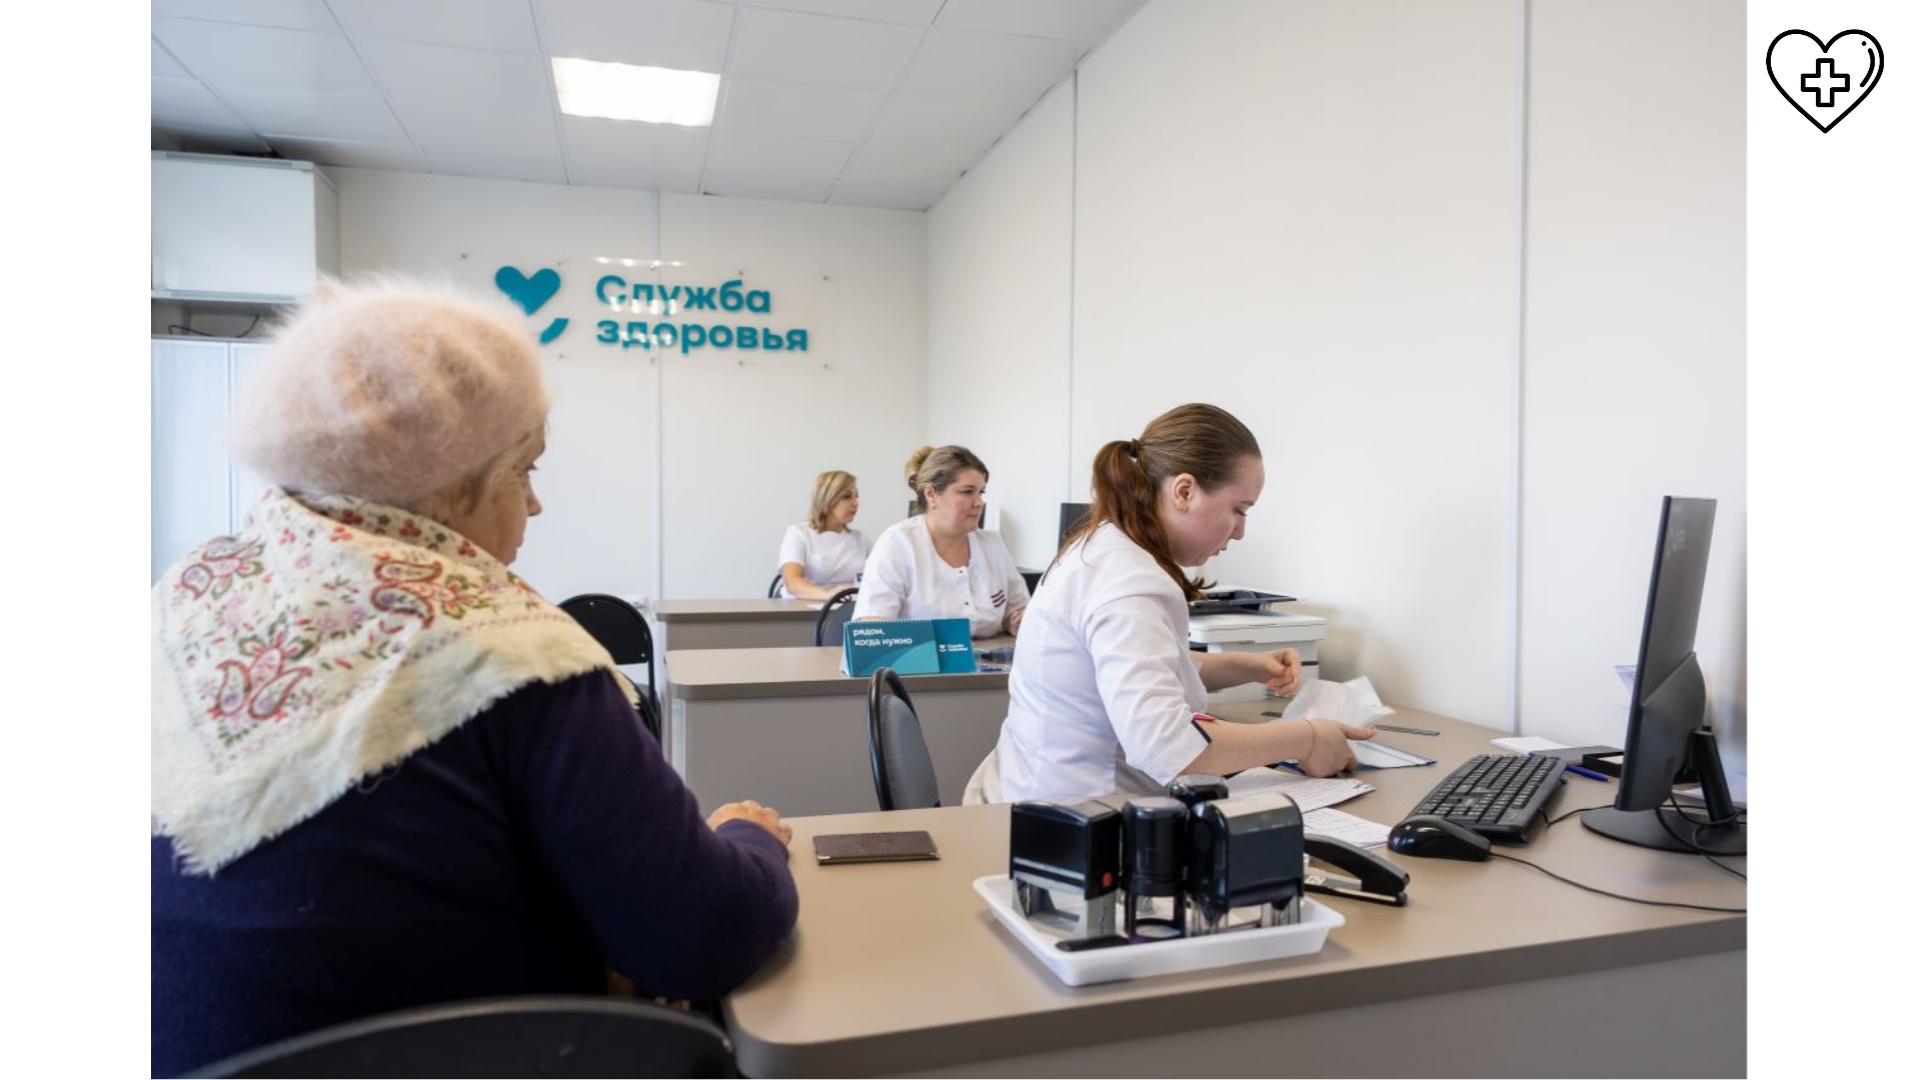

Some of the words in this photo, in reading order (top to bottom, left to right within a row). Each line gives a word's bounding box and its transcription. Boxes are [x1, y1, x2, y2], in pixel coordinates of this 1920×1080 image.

[595, 275, 772, 315] Служба
[595, 319, 808, 355] здоровья
[854, 639, 881, 647] когда
[882, 637, 913, 647] нужно
